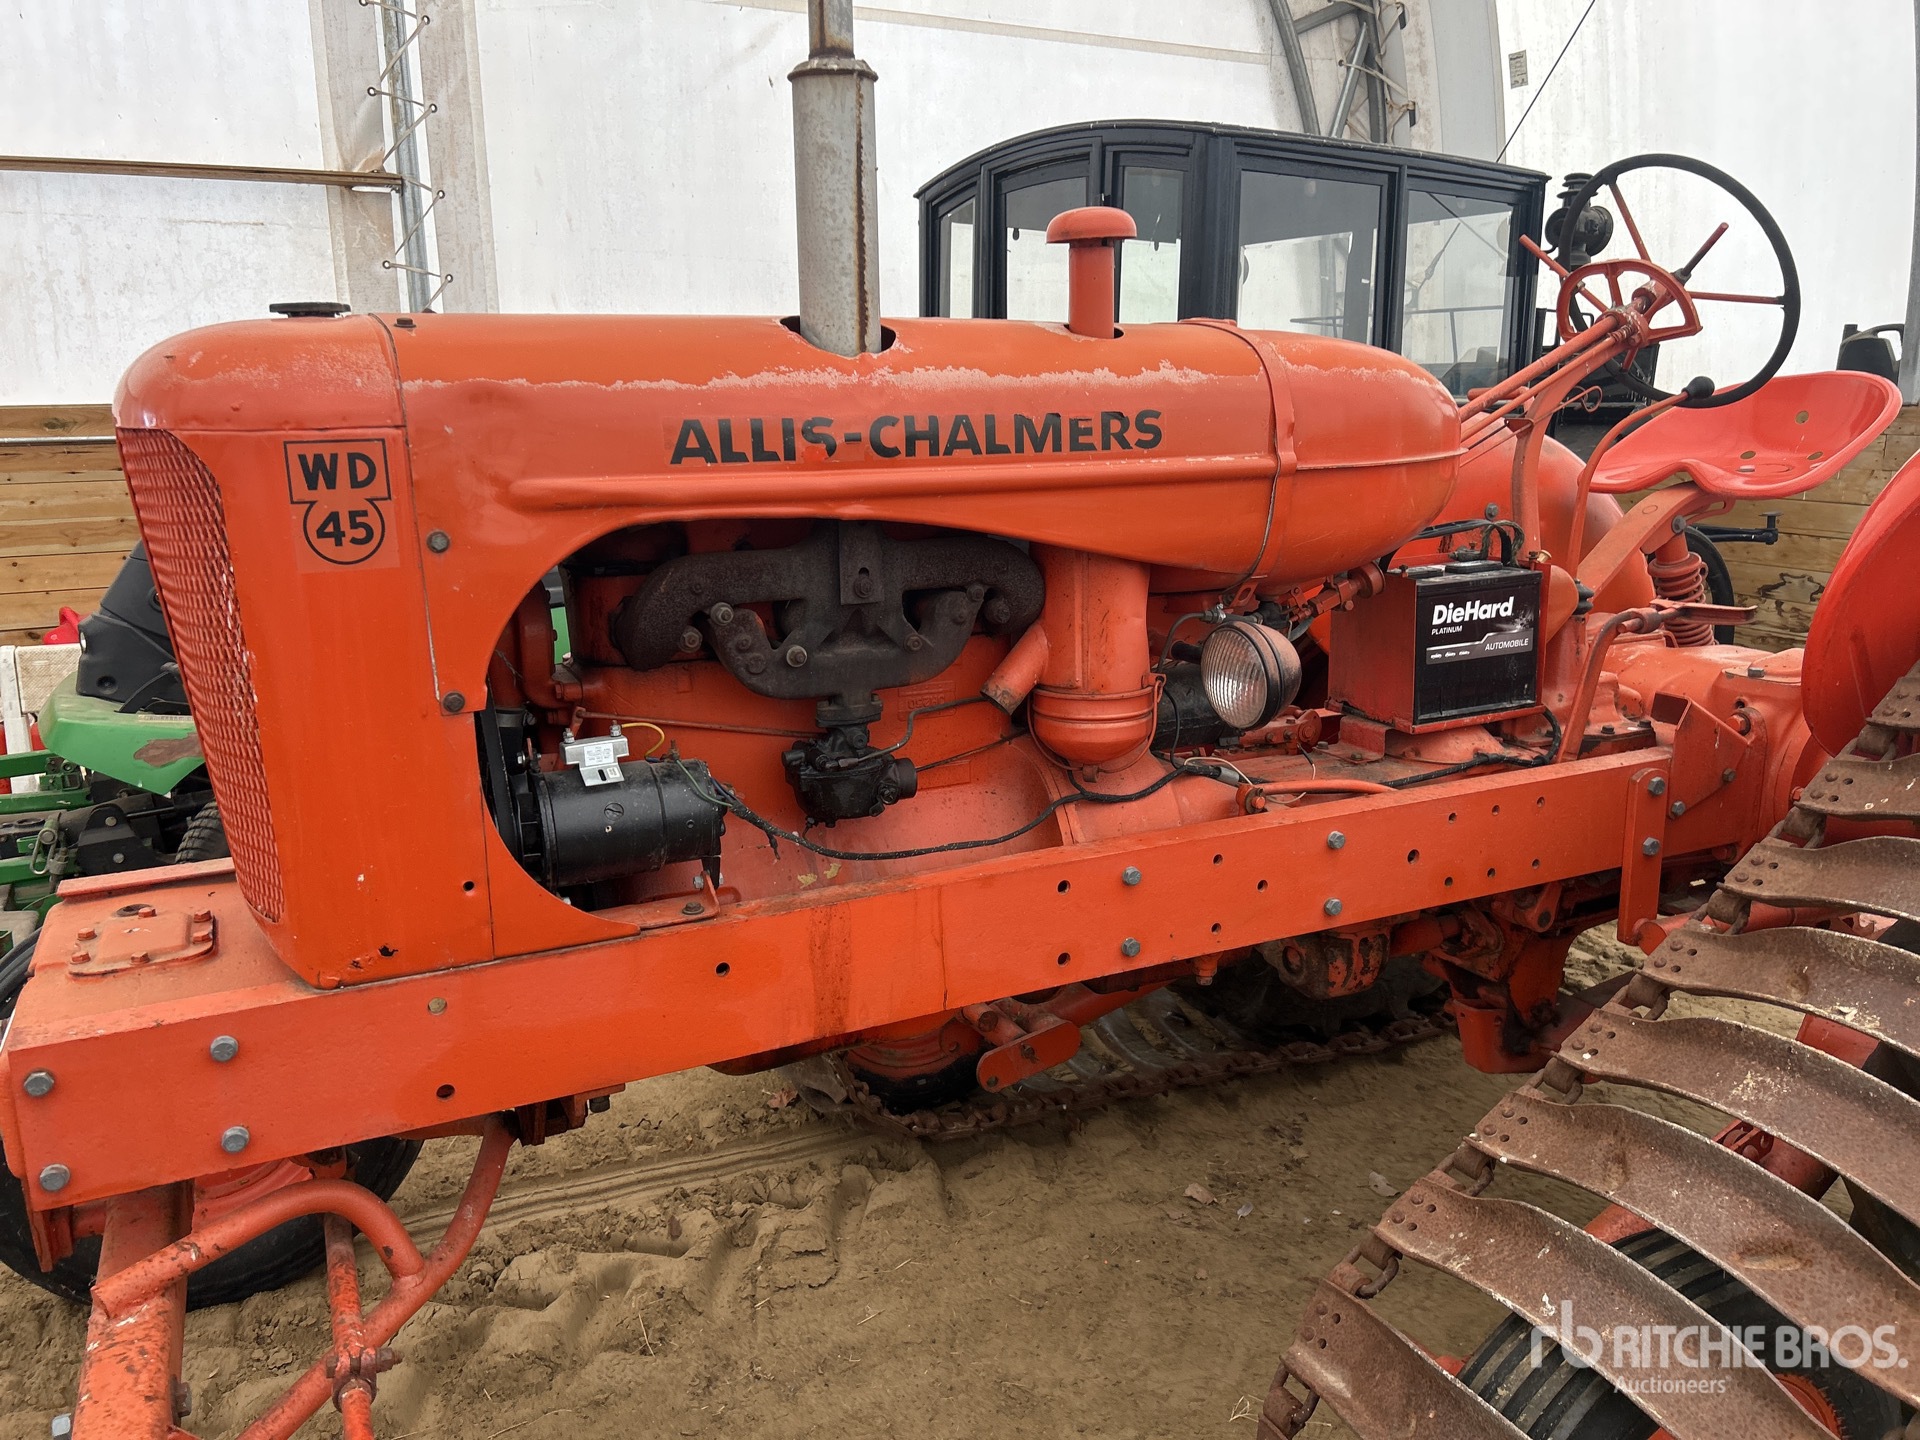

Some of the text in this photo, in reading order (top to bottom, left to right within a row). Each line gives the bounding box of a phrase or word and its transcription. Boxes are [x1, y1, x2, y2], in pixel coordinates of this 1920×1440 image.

[670, 409, 1162, 464] ALLIS-CHALMERS
[297, 452, 377, 491] WD
[316, 510, 374, 547] 45
[1432, 596, 1514, 625] DieHard
[1431, 625, 1463, 635] PLATINUM
[1485, 638, 1529, 651] AUTOMOBILE
